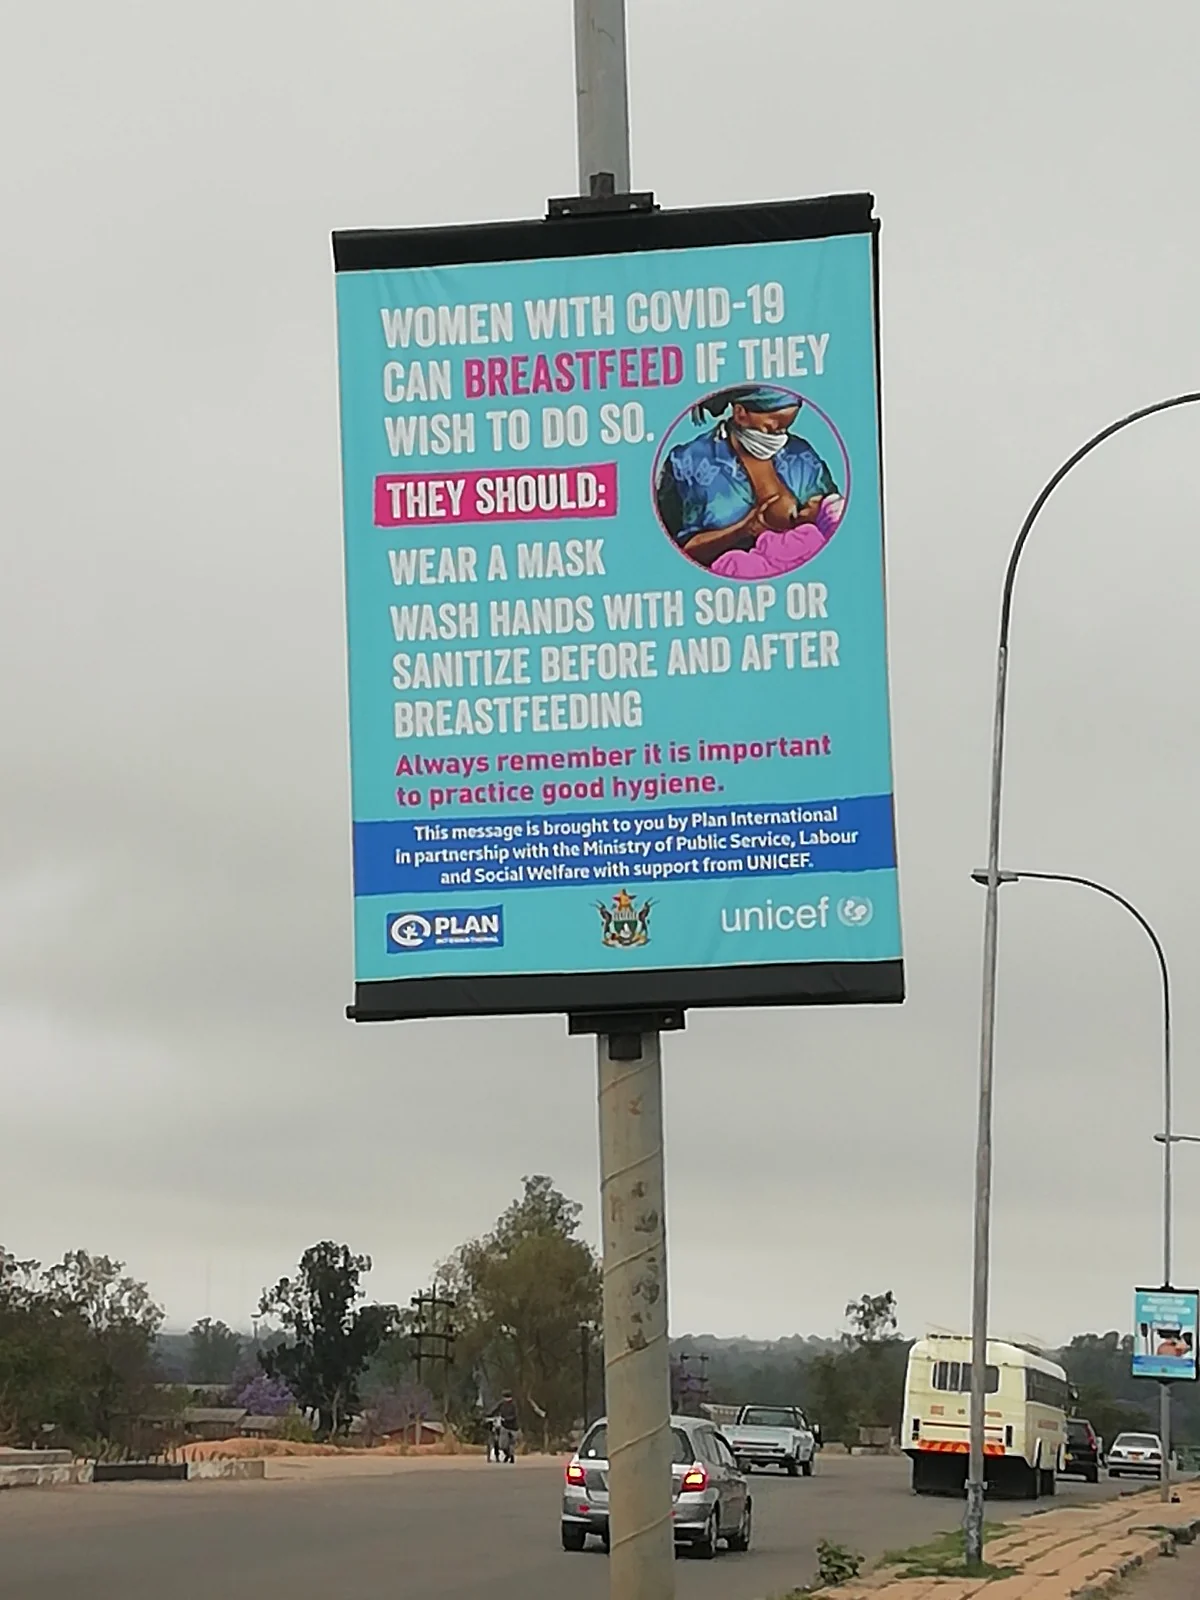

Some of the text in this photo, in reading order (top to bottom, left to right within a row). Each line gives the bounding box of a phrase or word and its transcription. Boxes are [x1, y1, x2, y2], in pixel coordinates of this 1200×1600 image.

[381, 282, 784, 348] WOMEN WITH COVID-19
[383, 334, 830, 403] CAN BREASTFEED IF THEY
[385, 403, 654, 456] WISH TO DO SO.
[387, 472, 605, 518] THEY SHOULD:
[389, 540, 605, 585] WEAR A MASK
[390, 582, 828, 641] WASH HANDS WITH SOAP OR
[393, 631, 839, 690] SANITIZE BEFORE AND AFTER
[395, 690, 642, 738] BREASTFEEDING
[396, 735, 831, 778] Always remember it is important
[396, 773, 724, 809] to practice good hygiene.
[415, 808, 837, 842] This message is brought to you by Plan International
[396, 828, 858, 868] in partnership with the Ministry of Public Service, Labour
[441, 853, 814, 884] and Social Welfare with support from UNICEF.
[435, 914, 498, 935] PLAN
[722, 897, 829, 932] unicef
